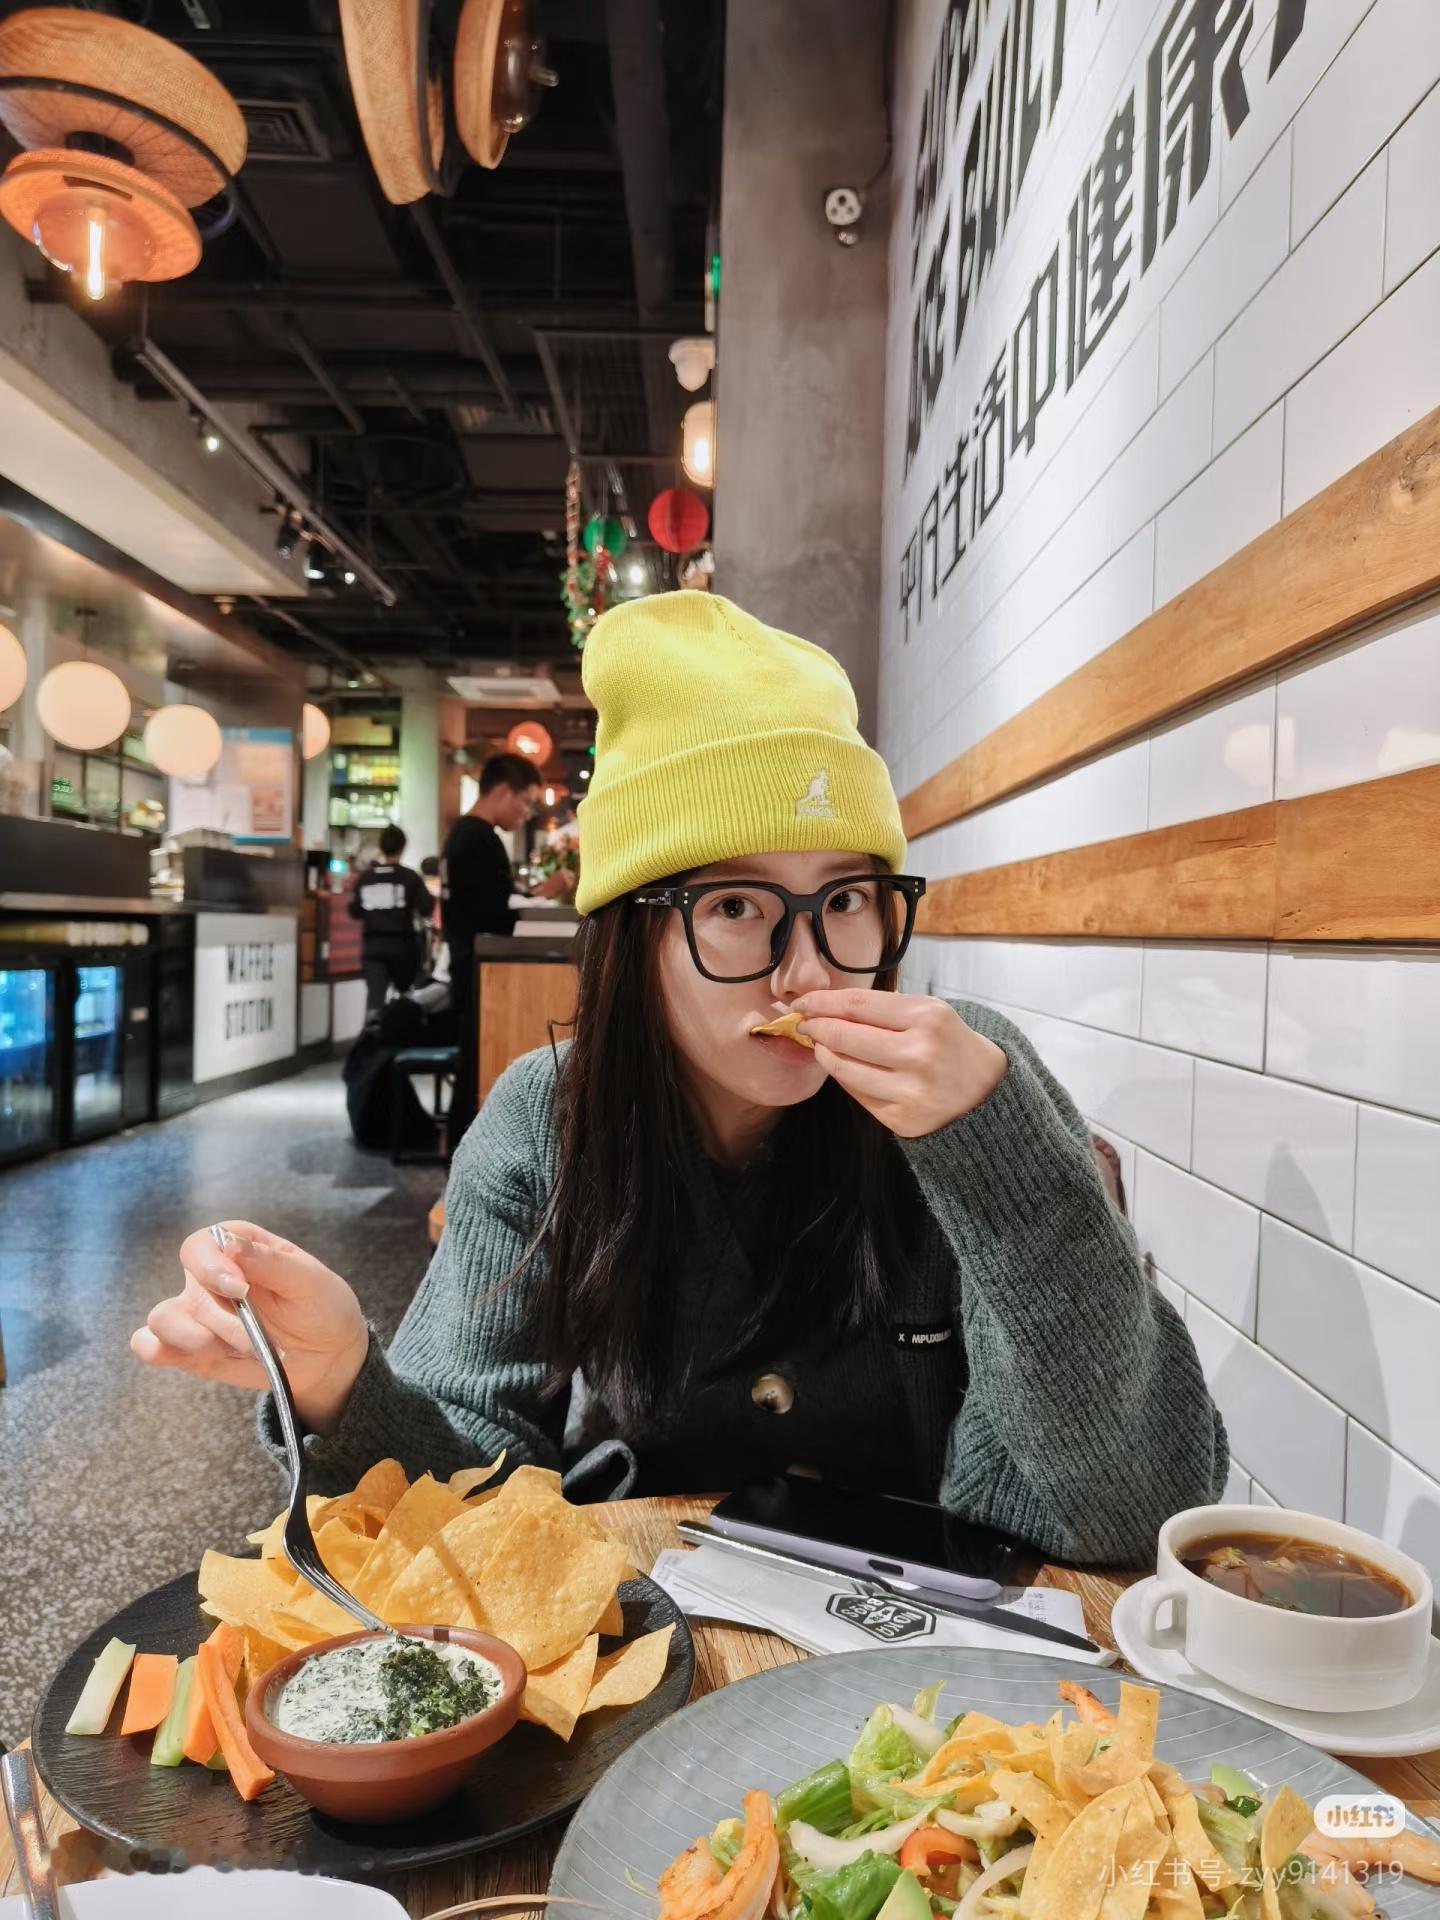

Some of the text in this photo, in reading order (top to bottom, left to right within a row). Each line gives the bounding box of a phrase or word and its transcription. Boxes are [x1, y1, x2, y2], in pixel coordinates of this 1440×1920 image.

[901, 0, 1304, 643] 平凡生活中健康
